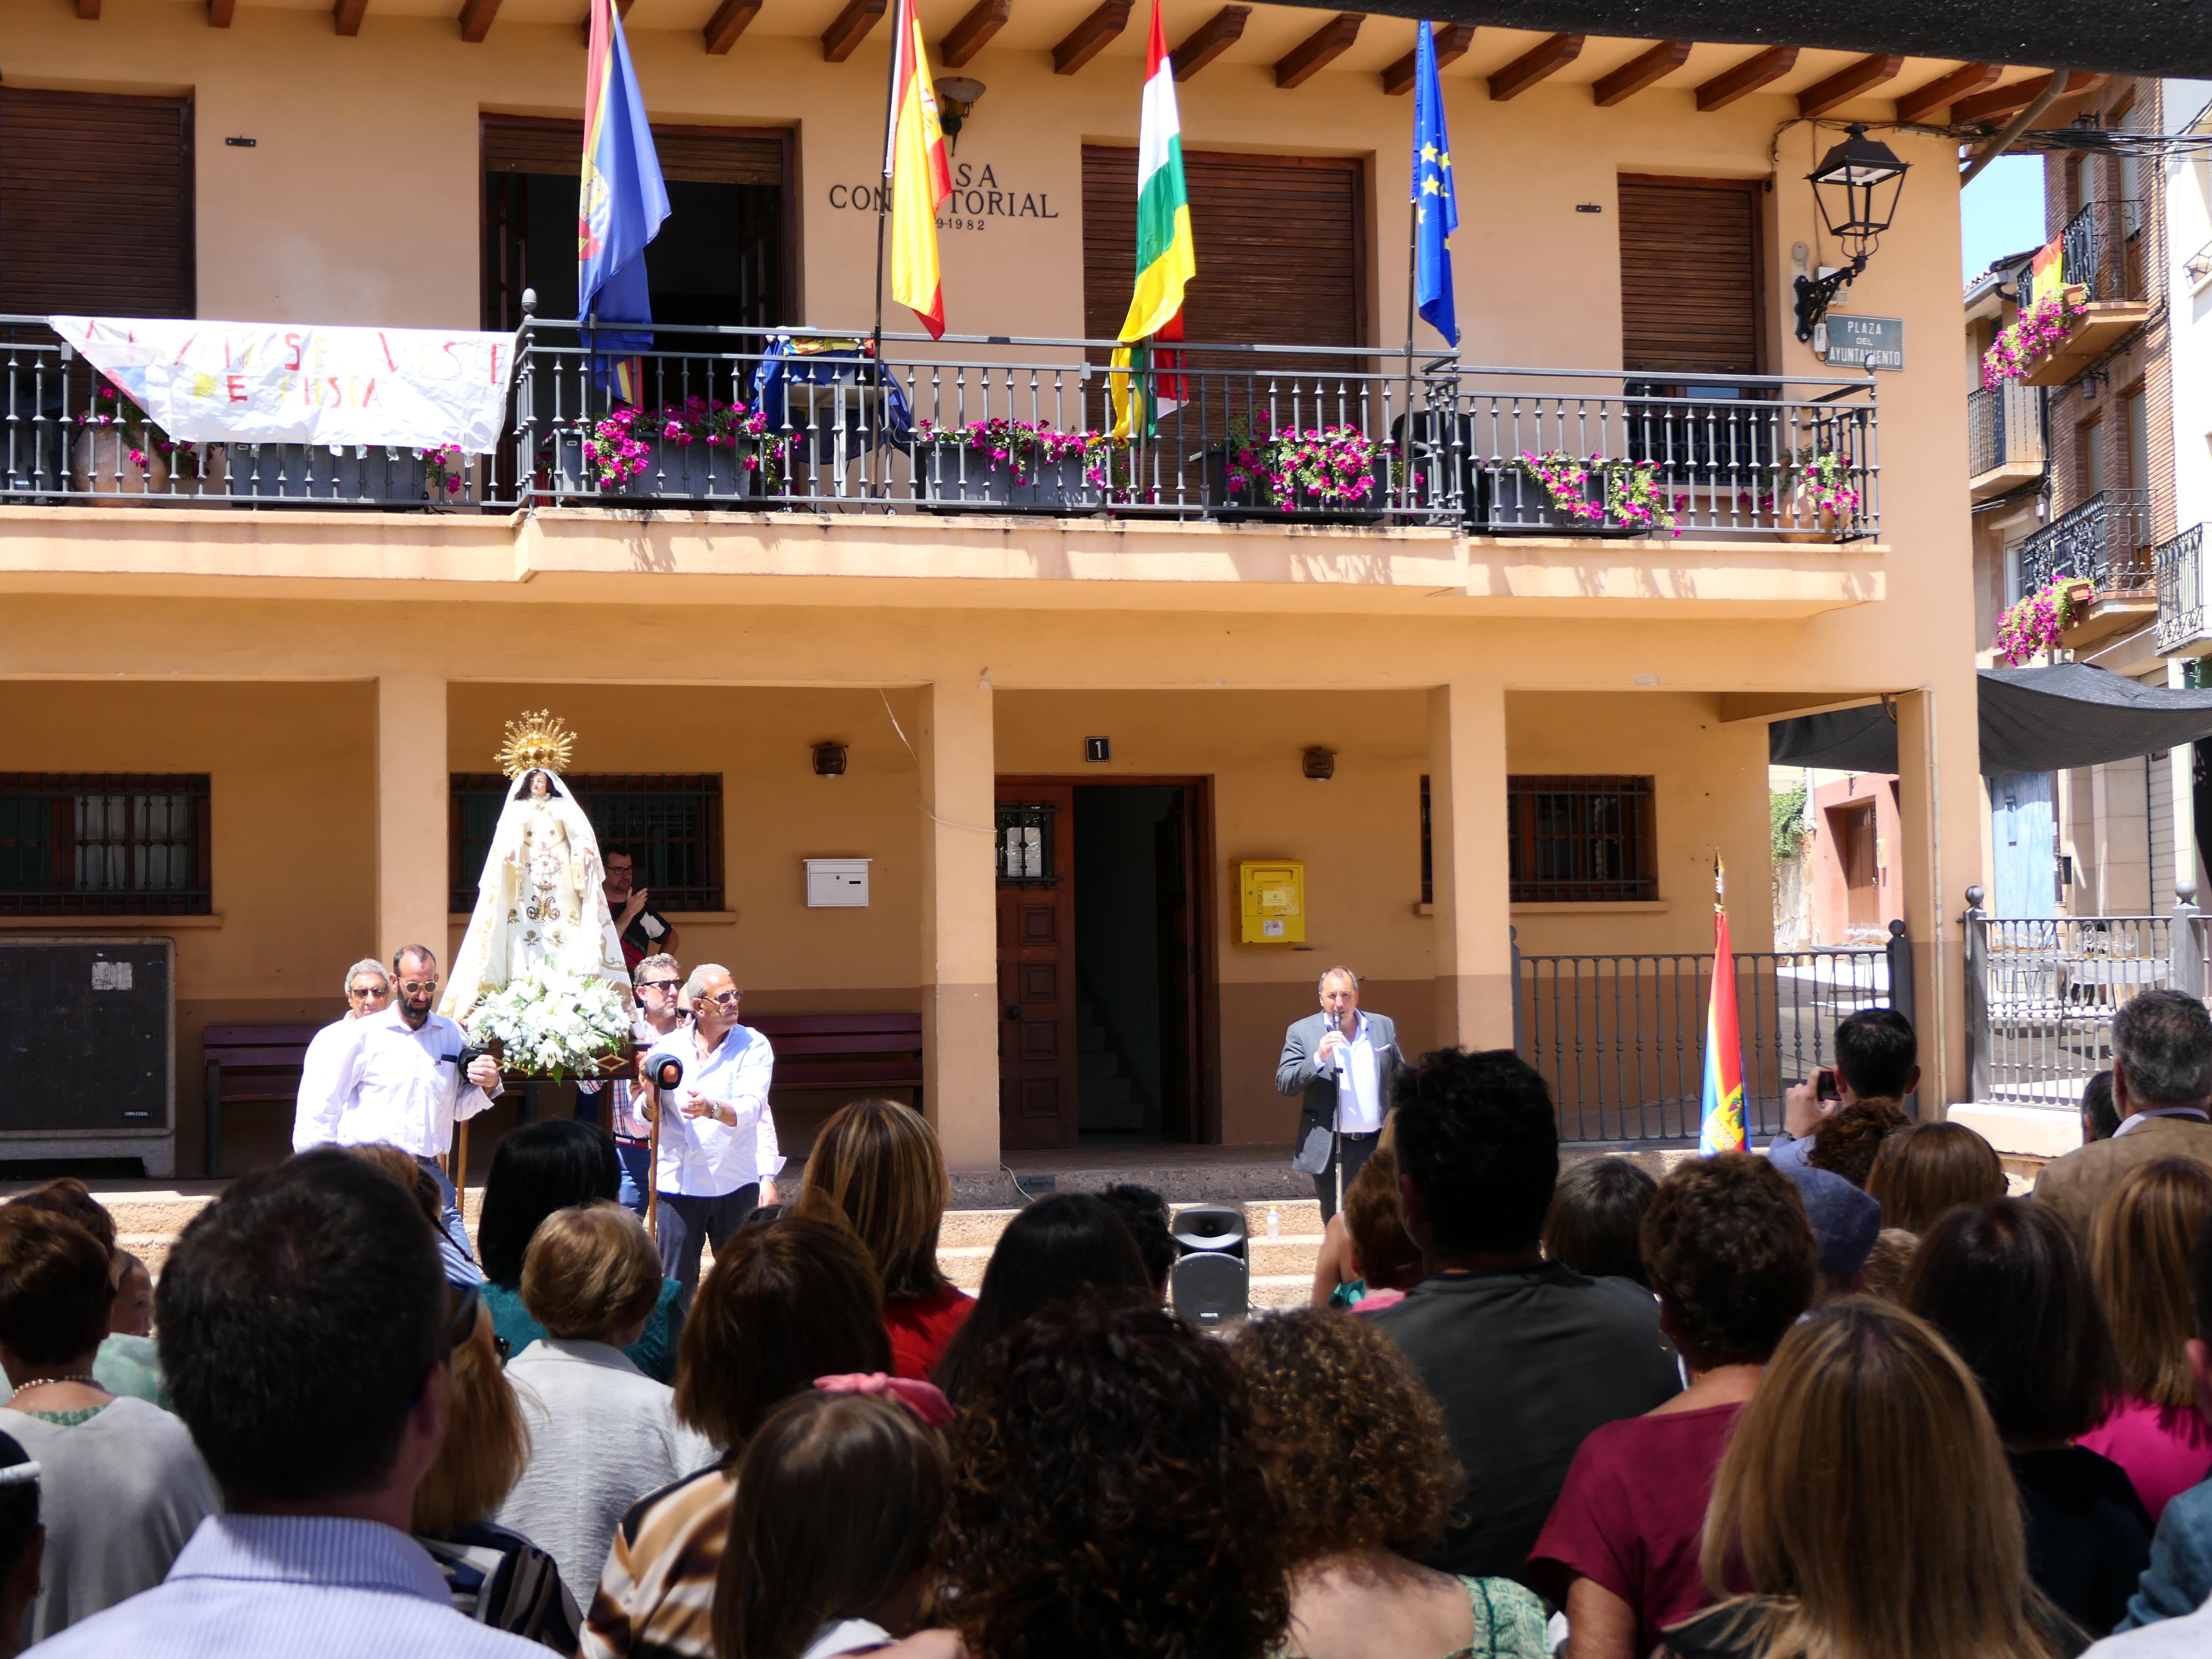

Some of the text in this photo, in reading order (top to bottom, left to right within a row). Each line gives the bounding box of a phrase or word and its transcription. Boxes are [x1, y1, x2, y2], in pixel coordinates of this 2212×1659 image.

[955, 164, 998, 188] SA
[829, 185, 1059, 218] CONTORIAL
[1847, 321, 1882, 335] PLAZA
[1095, 741, 1101, 758] 1
